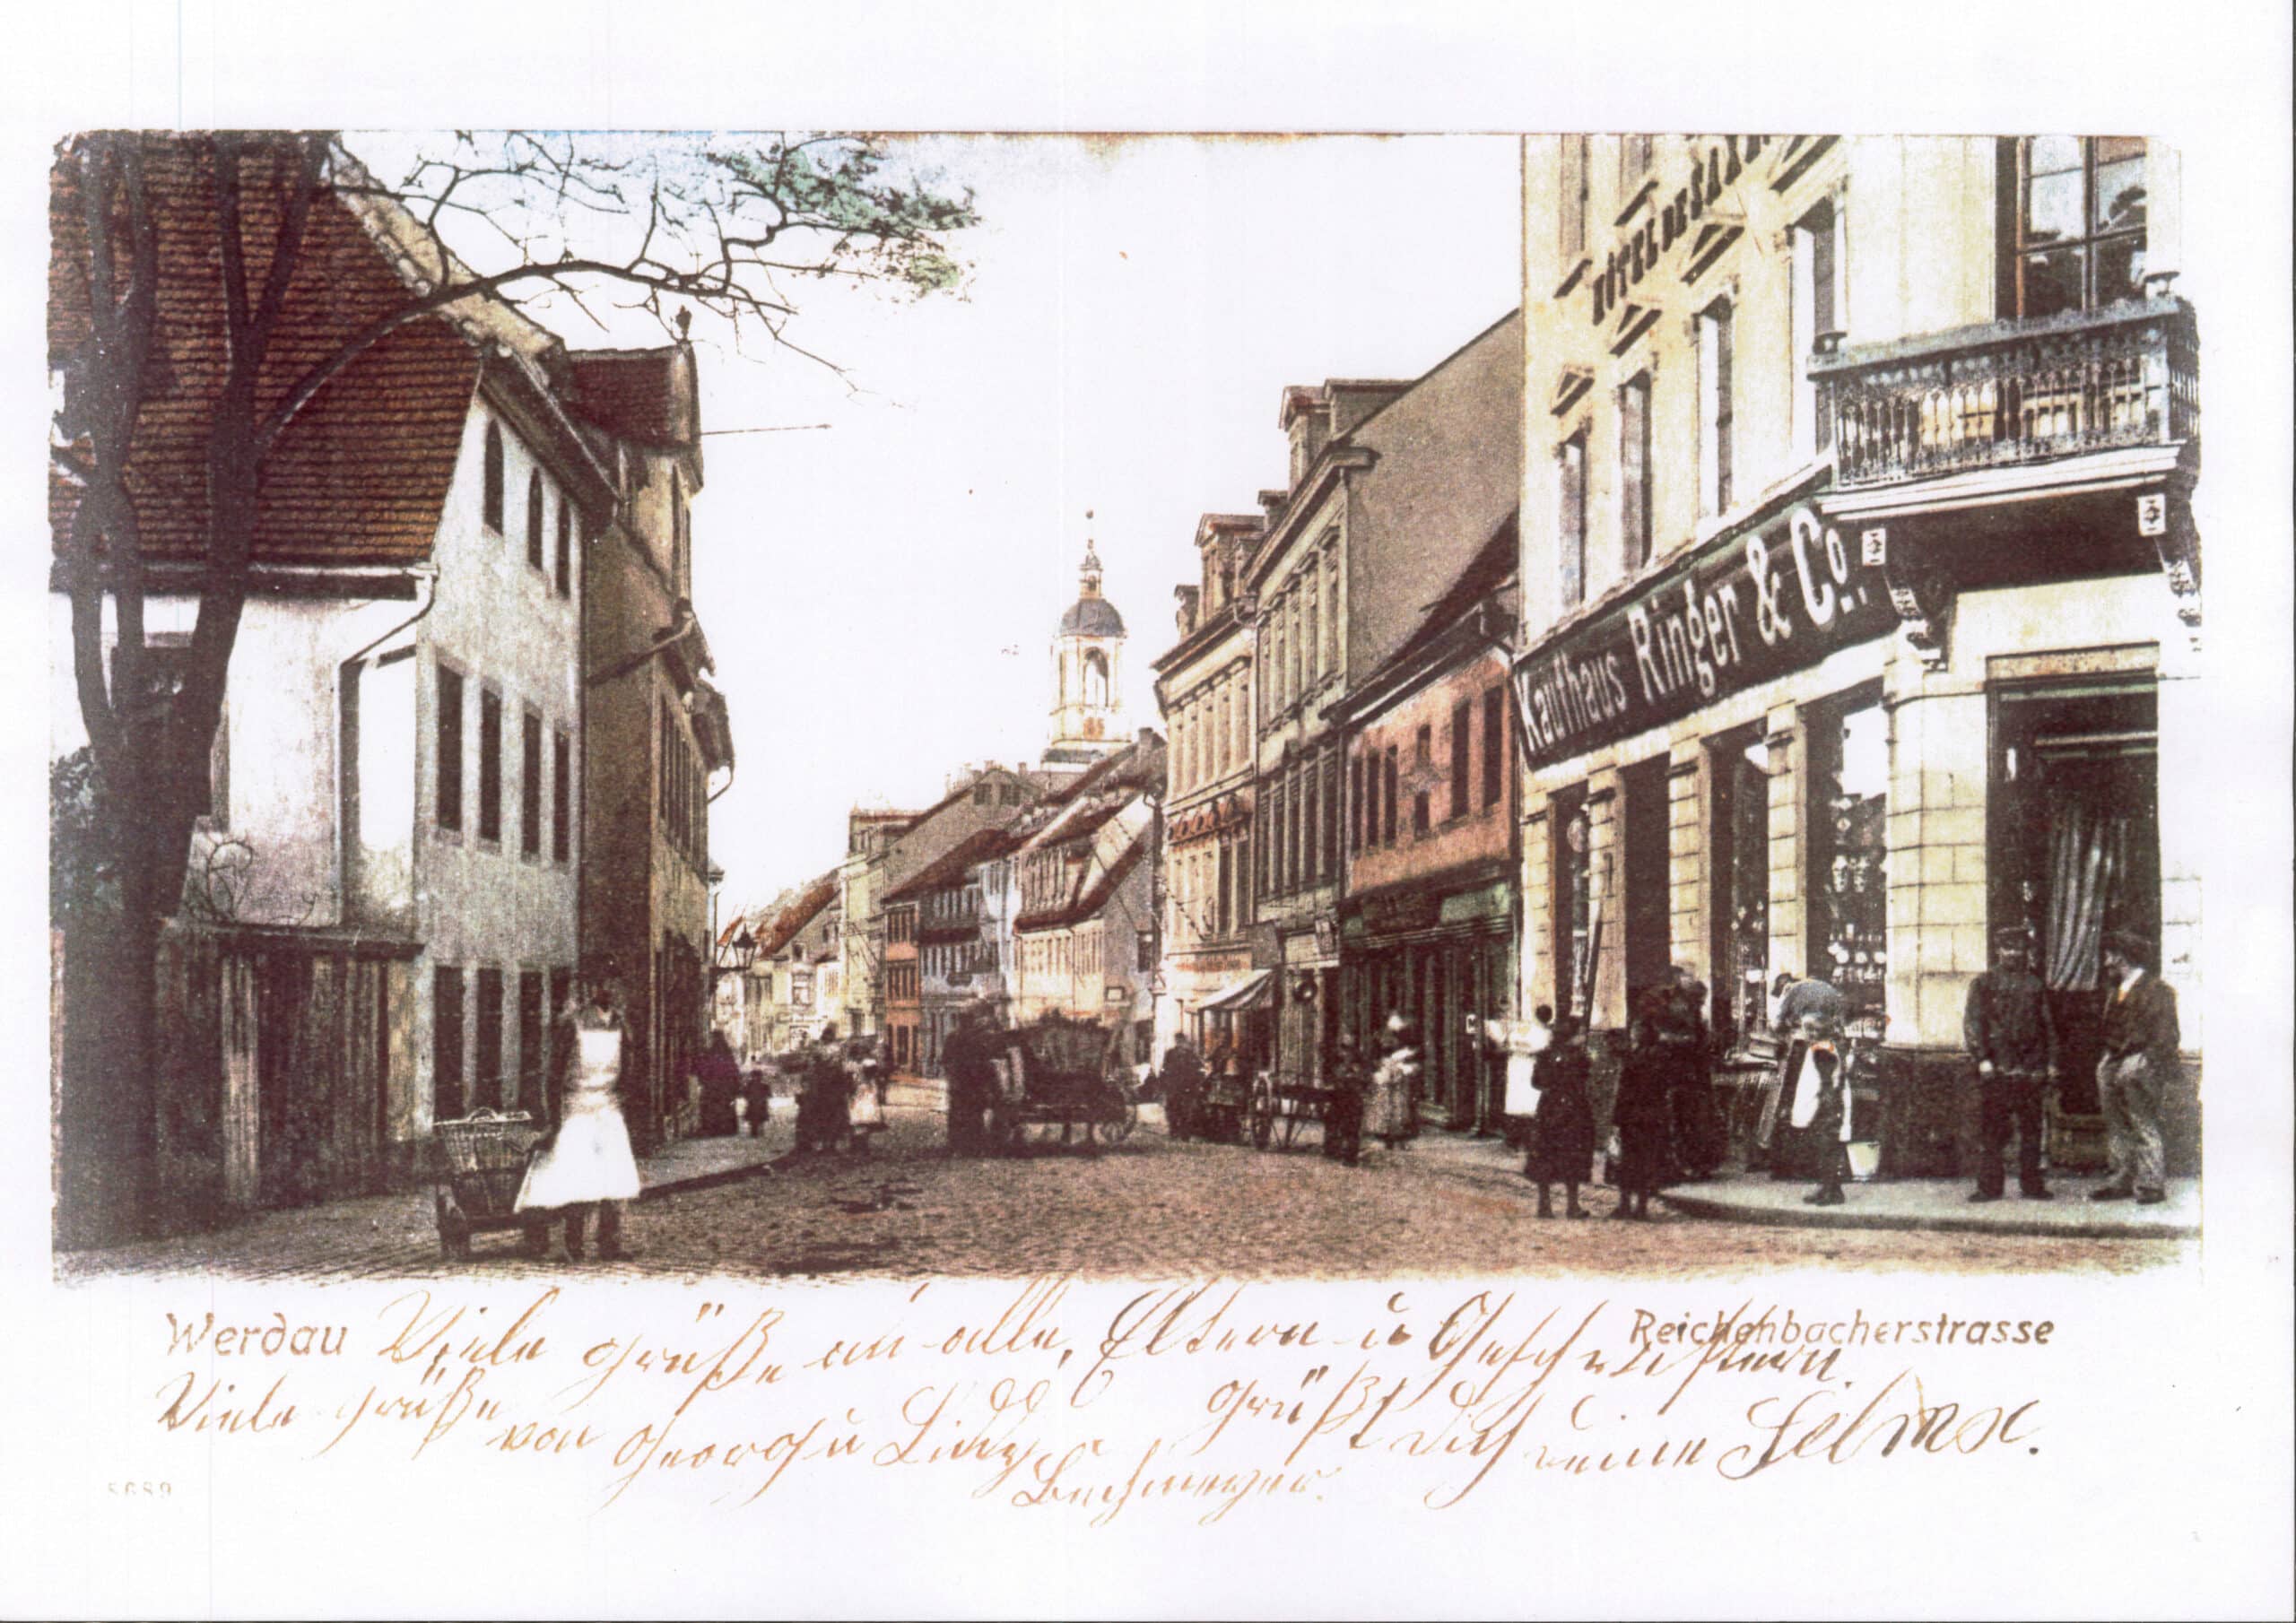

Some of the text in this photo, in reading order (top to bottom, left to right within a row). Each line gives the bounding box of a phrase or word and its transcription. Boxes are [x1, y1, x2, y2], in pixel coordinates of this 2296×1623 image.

[1513, 649, 1627, 755] Kaufhaus
[1626, 578, 1741, 703] Ringer
[1745, 534, 1792, 646] &
